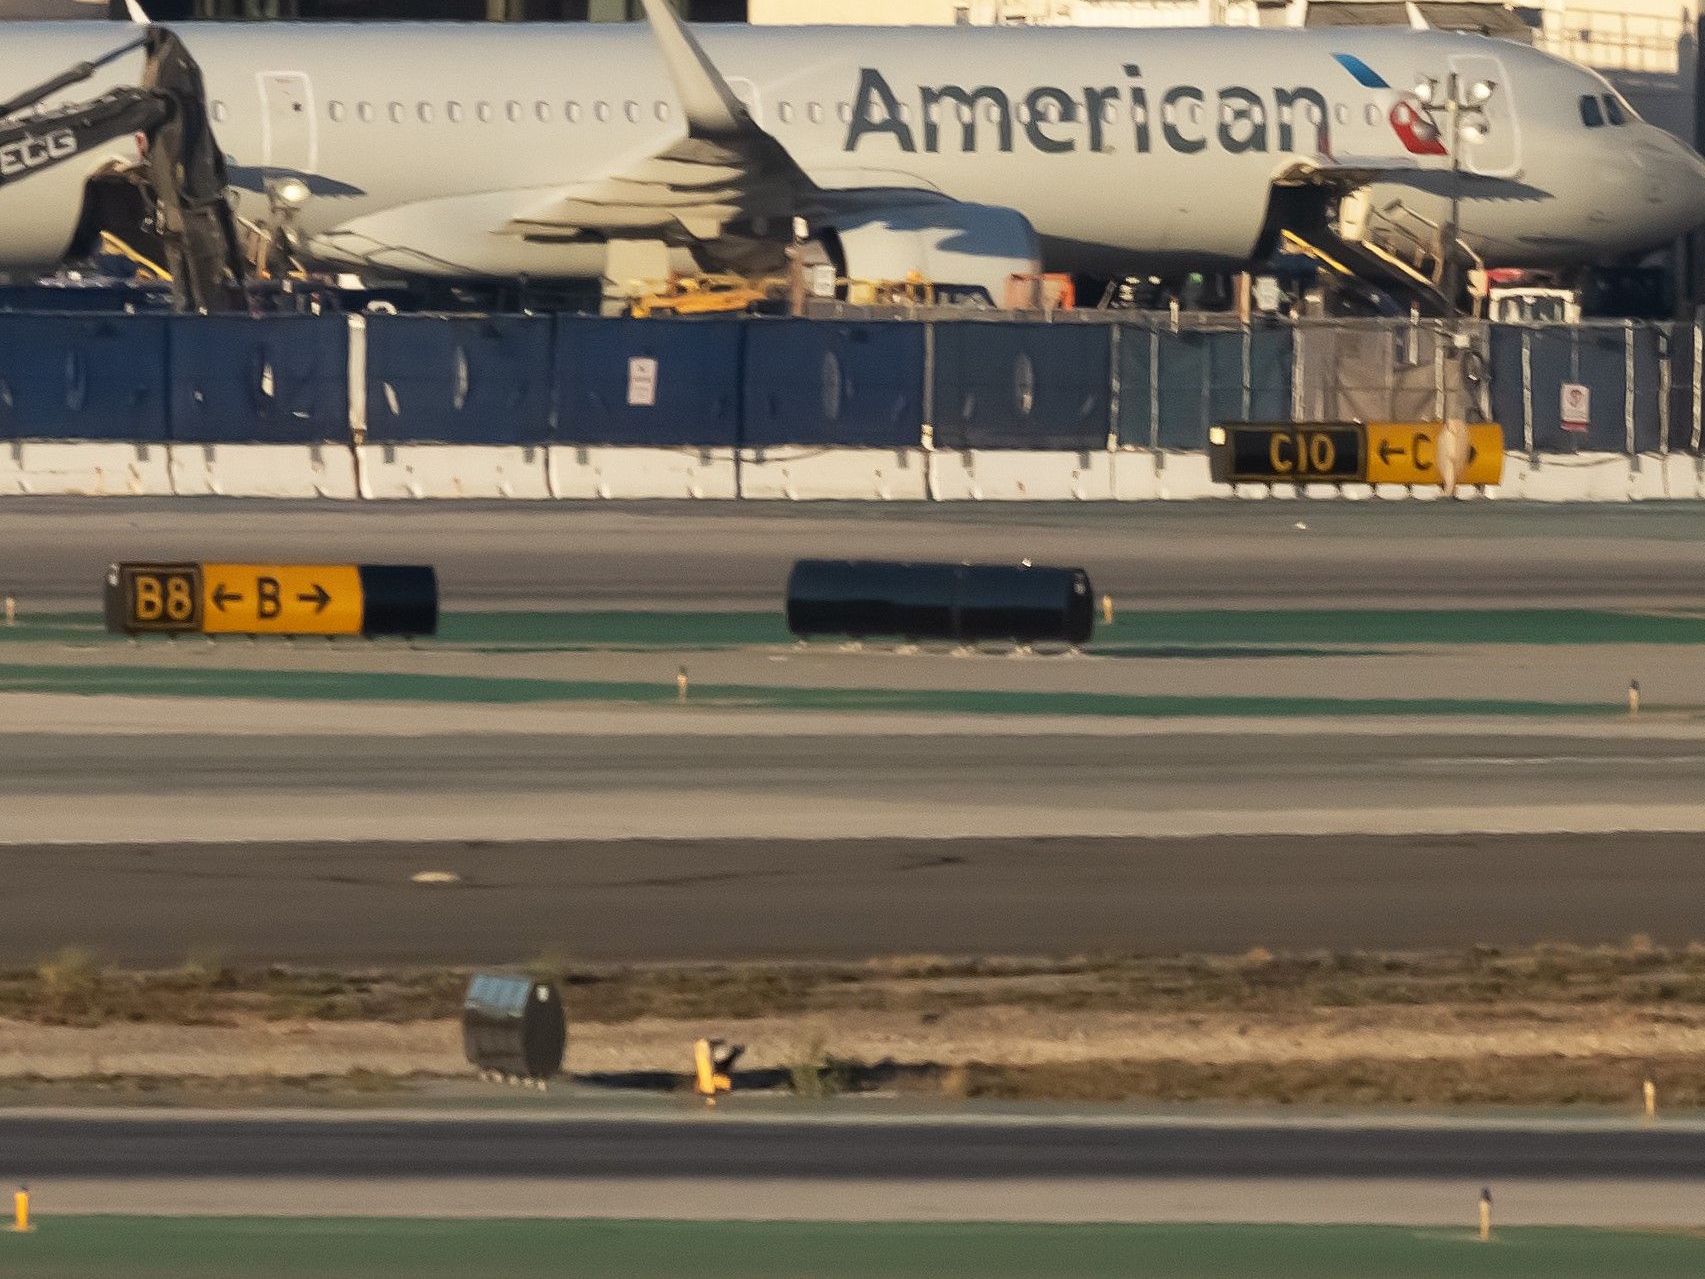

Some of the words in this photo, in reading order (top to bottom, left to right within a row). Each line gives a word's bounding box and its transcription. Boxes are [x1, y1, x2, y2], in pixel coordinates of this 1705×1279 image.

[843, 62, 1334, 155] American
[1269, 431, 1336, 474] C10
[1413, 432, 1434, 470] C
[135, 575, 192, 621] B8
[257, 576, 282, 620] B
